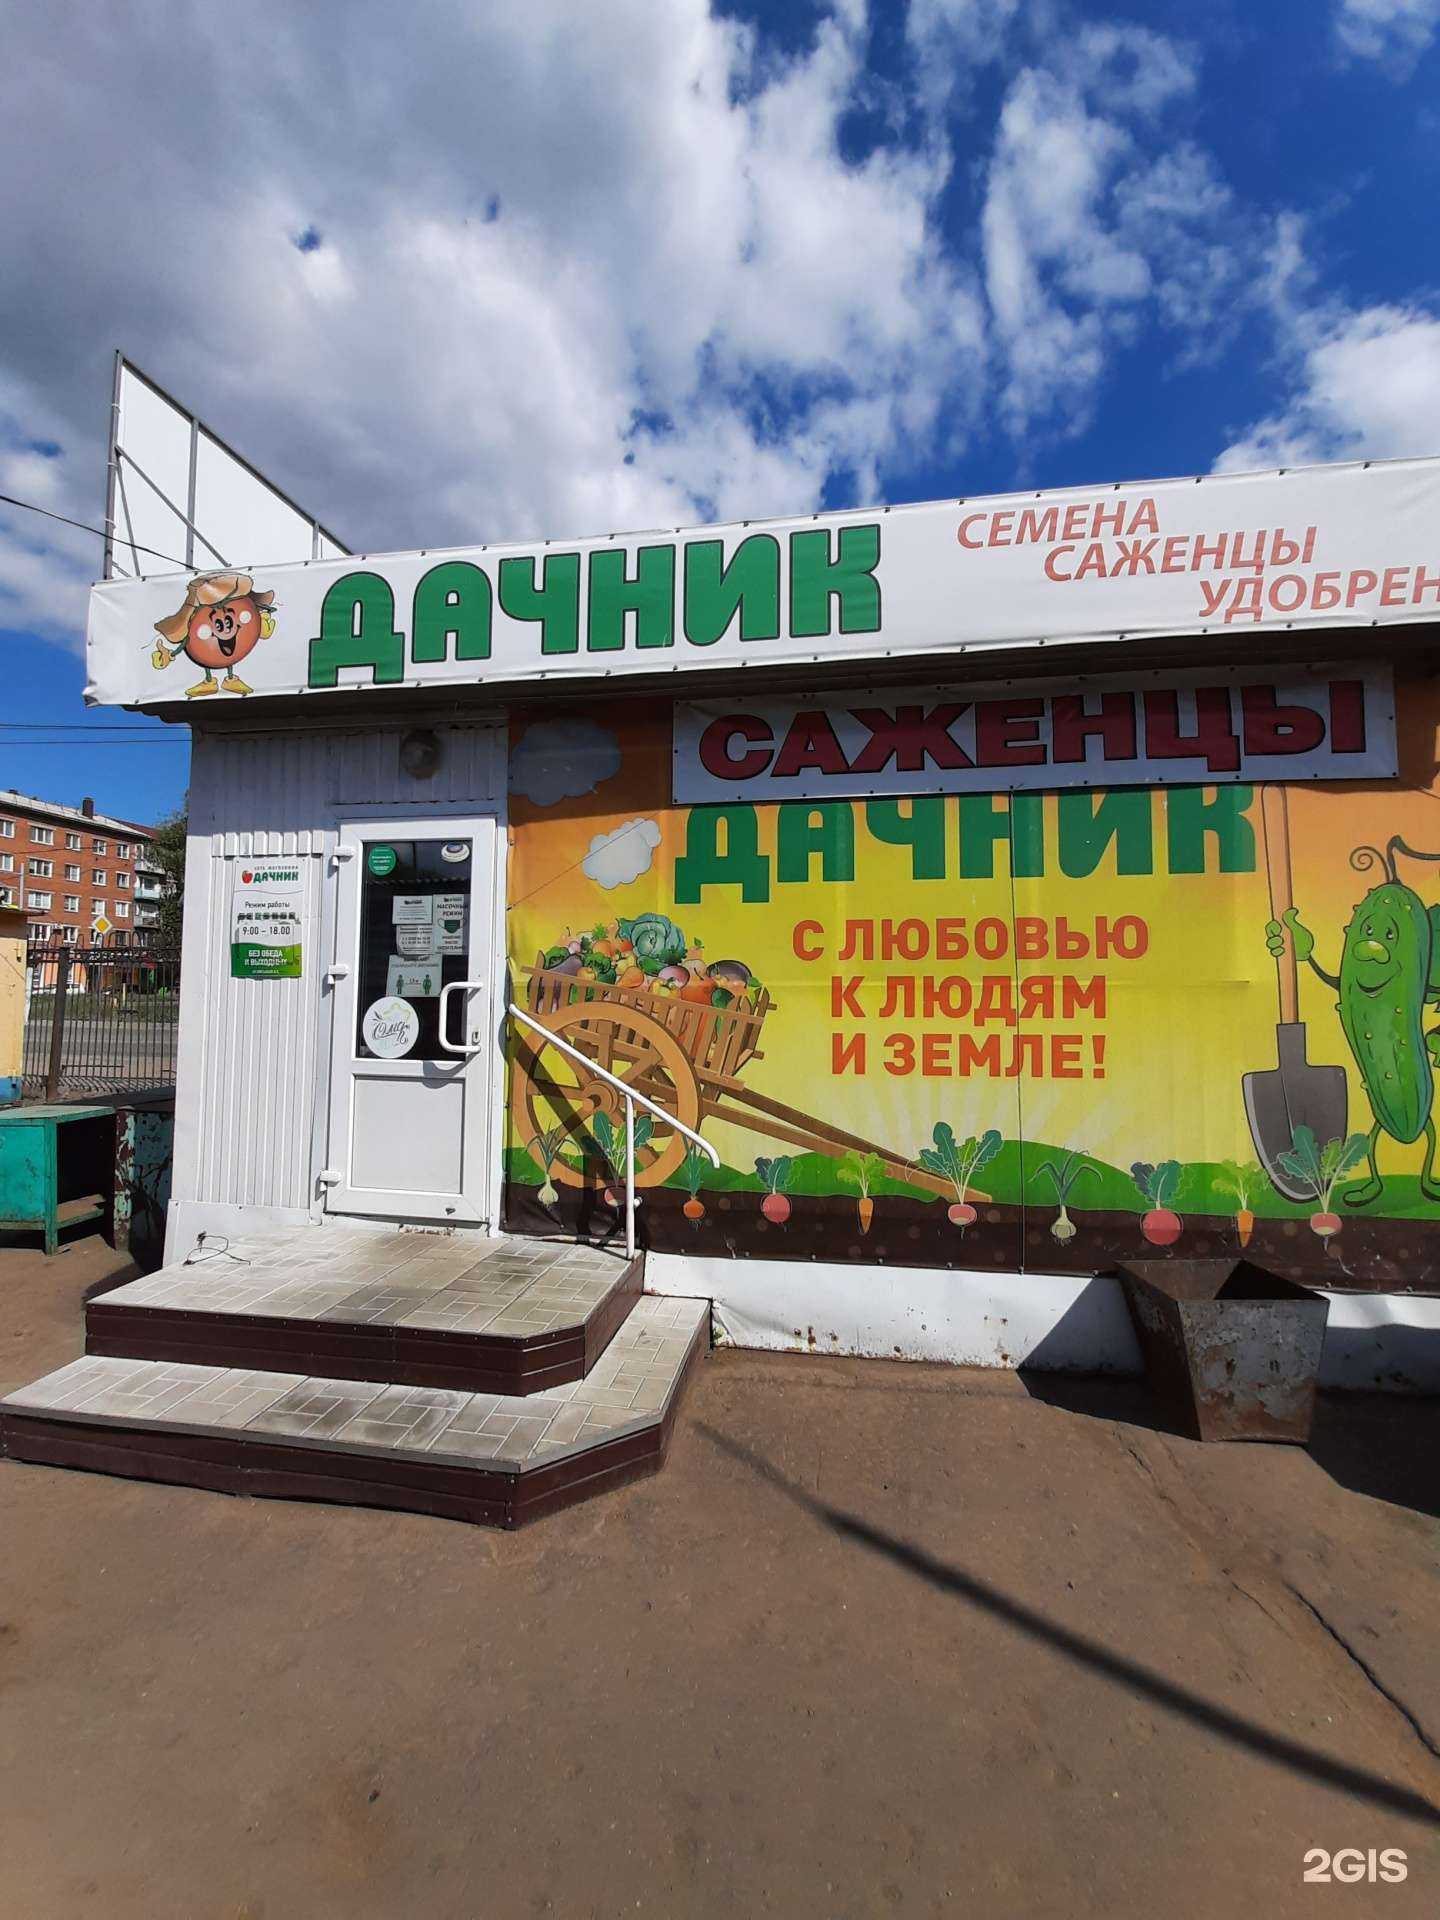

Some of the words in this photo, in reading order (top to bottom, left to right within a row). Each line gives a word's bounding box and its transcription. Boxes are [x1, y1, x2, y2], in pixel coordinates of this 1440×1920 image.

[956, 497, 1160, 550] СЕМЕНА
[1043, 526, 1317, 582] САЖЕНЦЫ
[308, 524, 882, 689] ДАЧНИК
[698, 679, 1367, 781] САЖЕНЦЫ
[673, 784, 1257, 905] ДАЧНИК
[253, 871, 299, 883] ДАЧНИК
[268, 901, 290, 909] работы
[792, 918, 825, 962] С
[838, 915, 1149, 961] ЛЮБОВЬЮ
[831, 975, 866, 1018] К
[878, 975, 1107, 1027] ЛЮДЯМ
[831, 1032, 866, 1075] И
[883, 1032, 1106, 1079] ЗЕМЛЕ!
